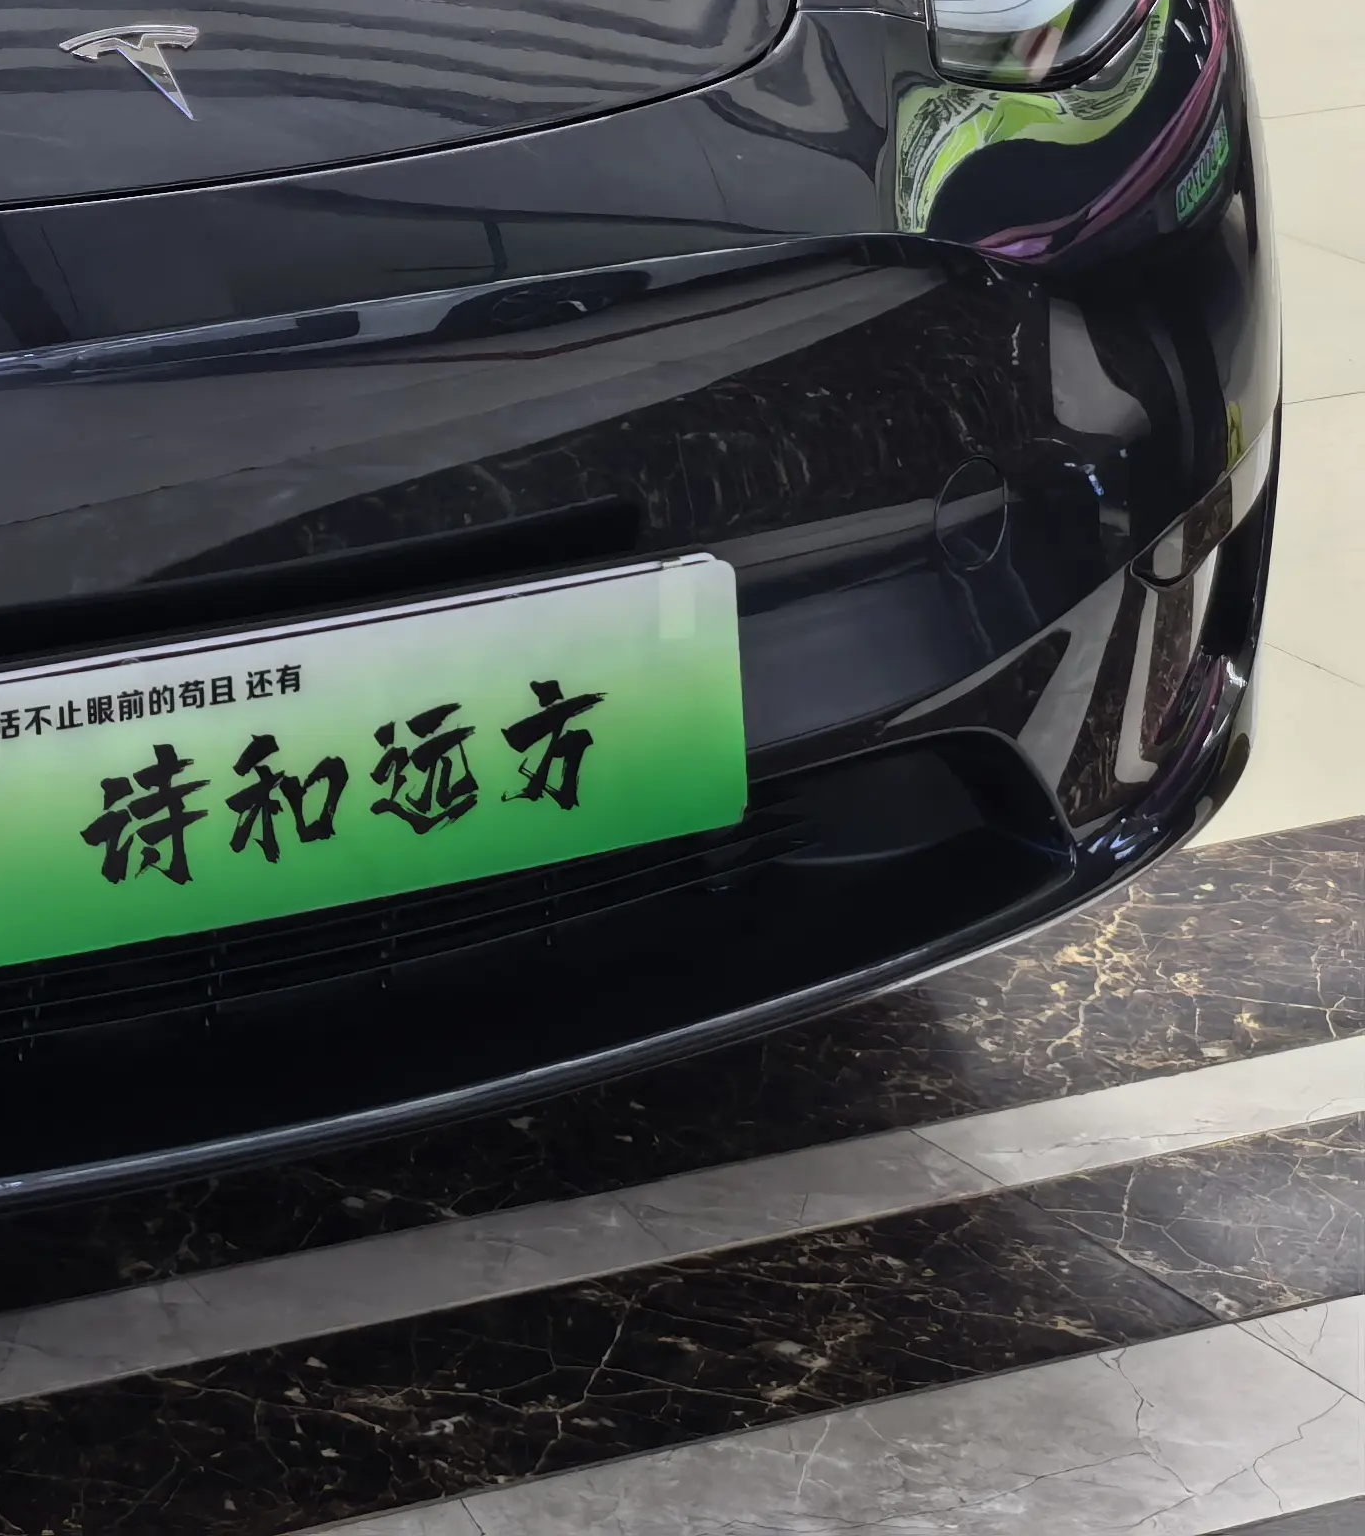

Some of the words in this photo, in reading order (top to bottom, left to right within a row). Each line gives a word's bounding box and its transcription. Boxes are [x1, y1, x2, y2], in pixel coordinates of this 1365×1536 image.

[245, 664, 303, 701] 还有
[79, 679, 607, 886] 诗和远方
